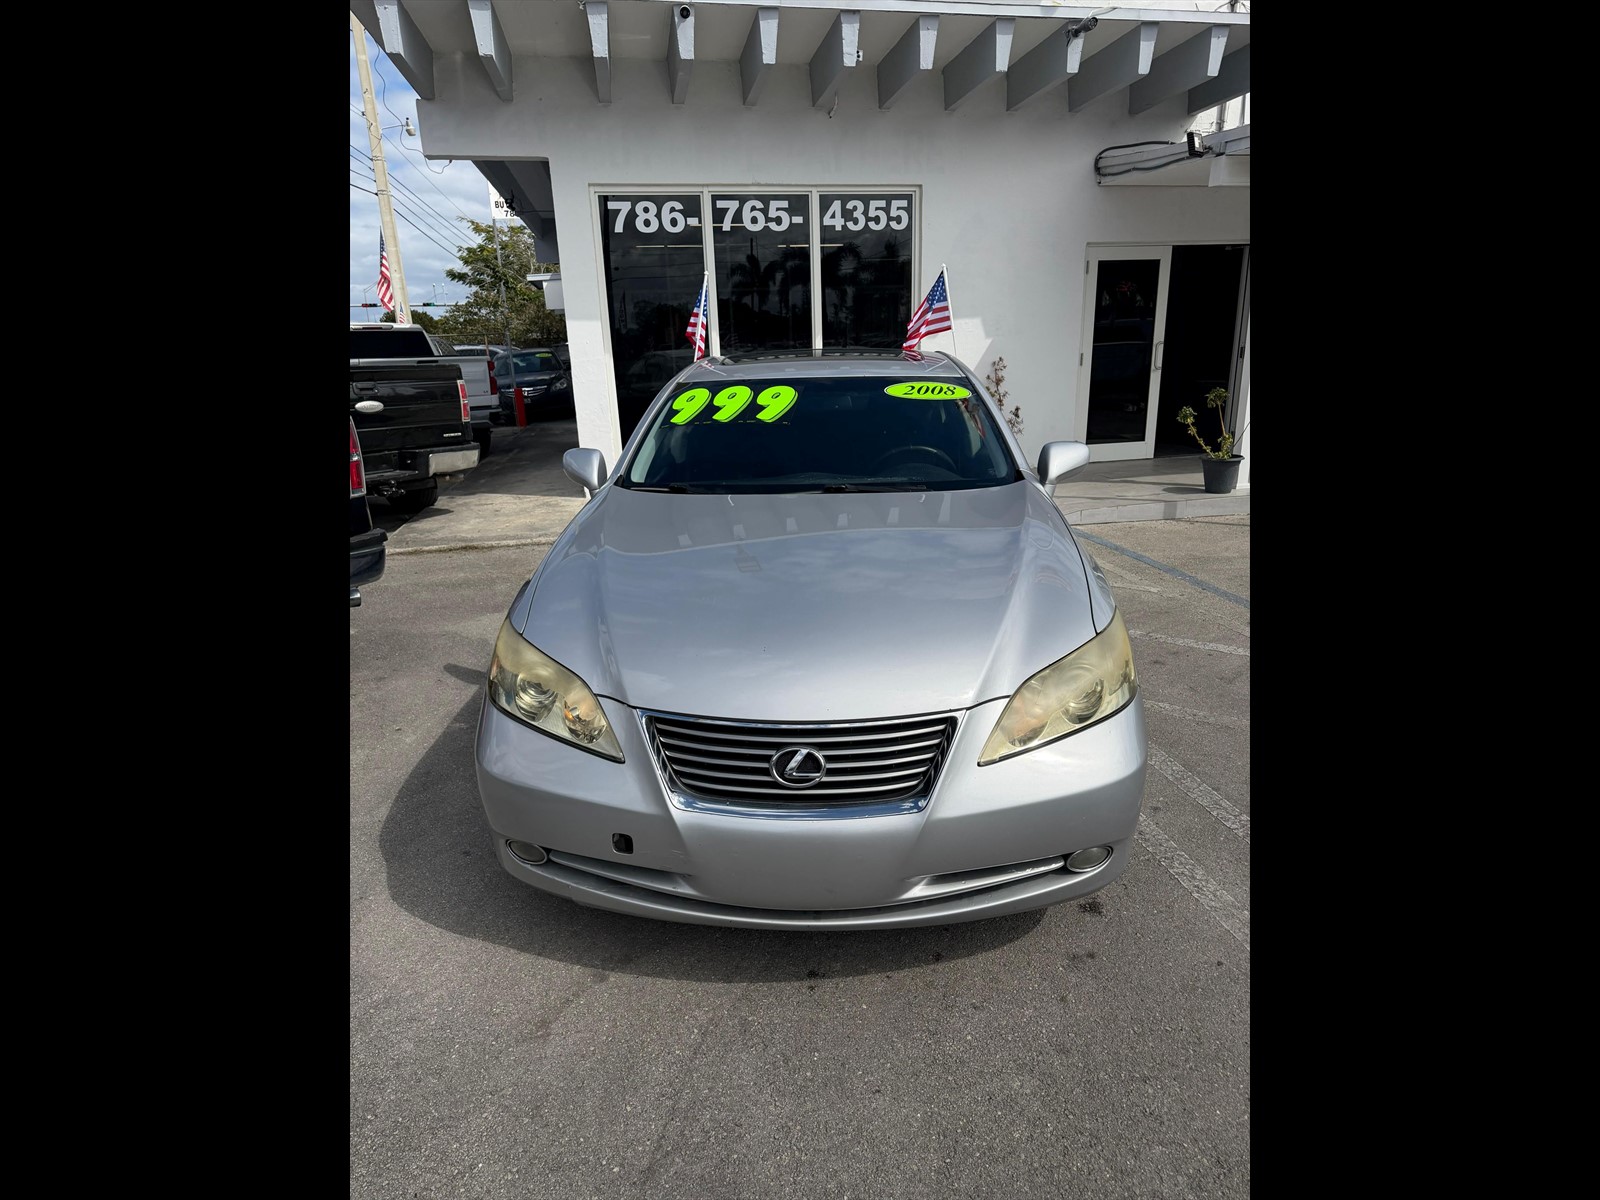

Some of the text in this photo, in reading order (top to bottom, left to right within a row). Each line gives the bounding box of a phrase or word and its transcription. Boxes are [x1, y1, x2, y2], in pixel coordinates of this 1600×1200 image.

[494, 200, 505, 209] BU
[504, 210, 515, 218] 78
[607, 200, 909, 233] 786- 765- 4355
[903, 385, 956, 396] 2008
[670, 385, 798, 425] 999
